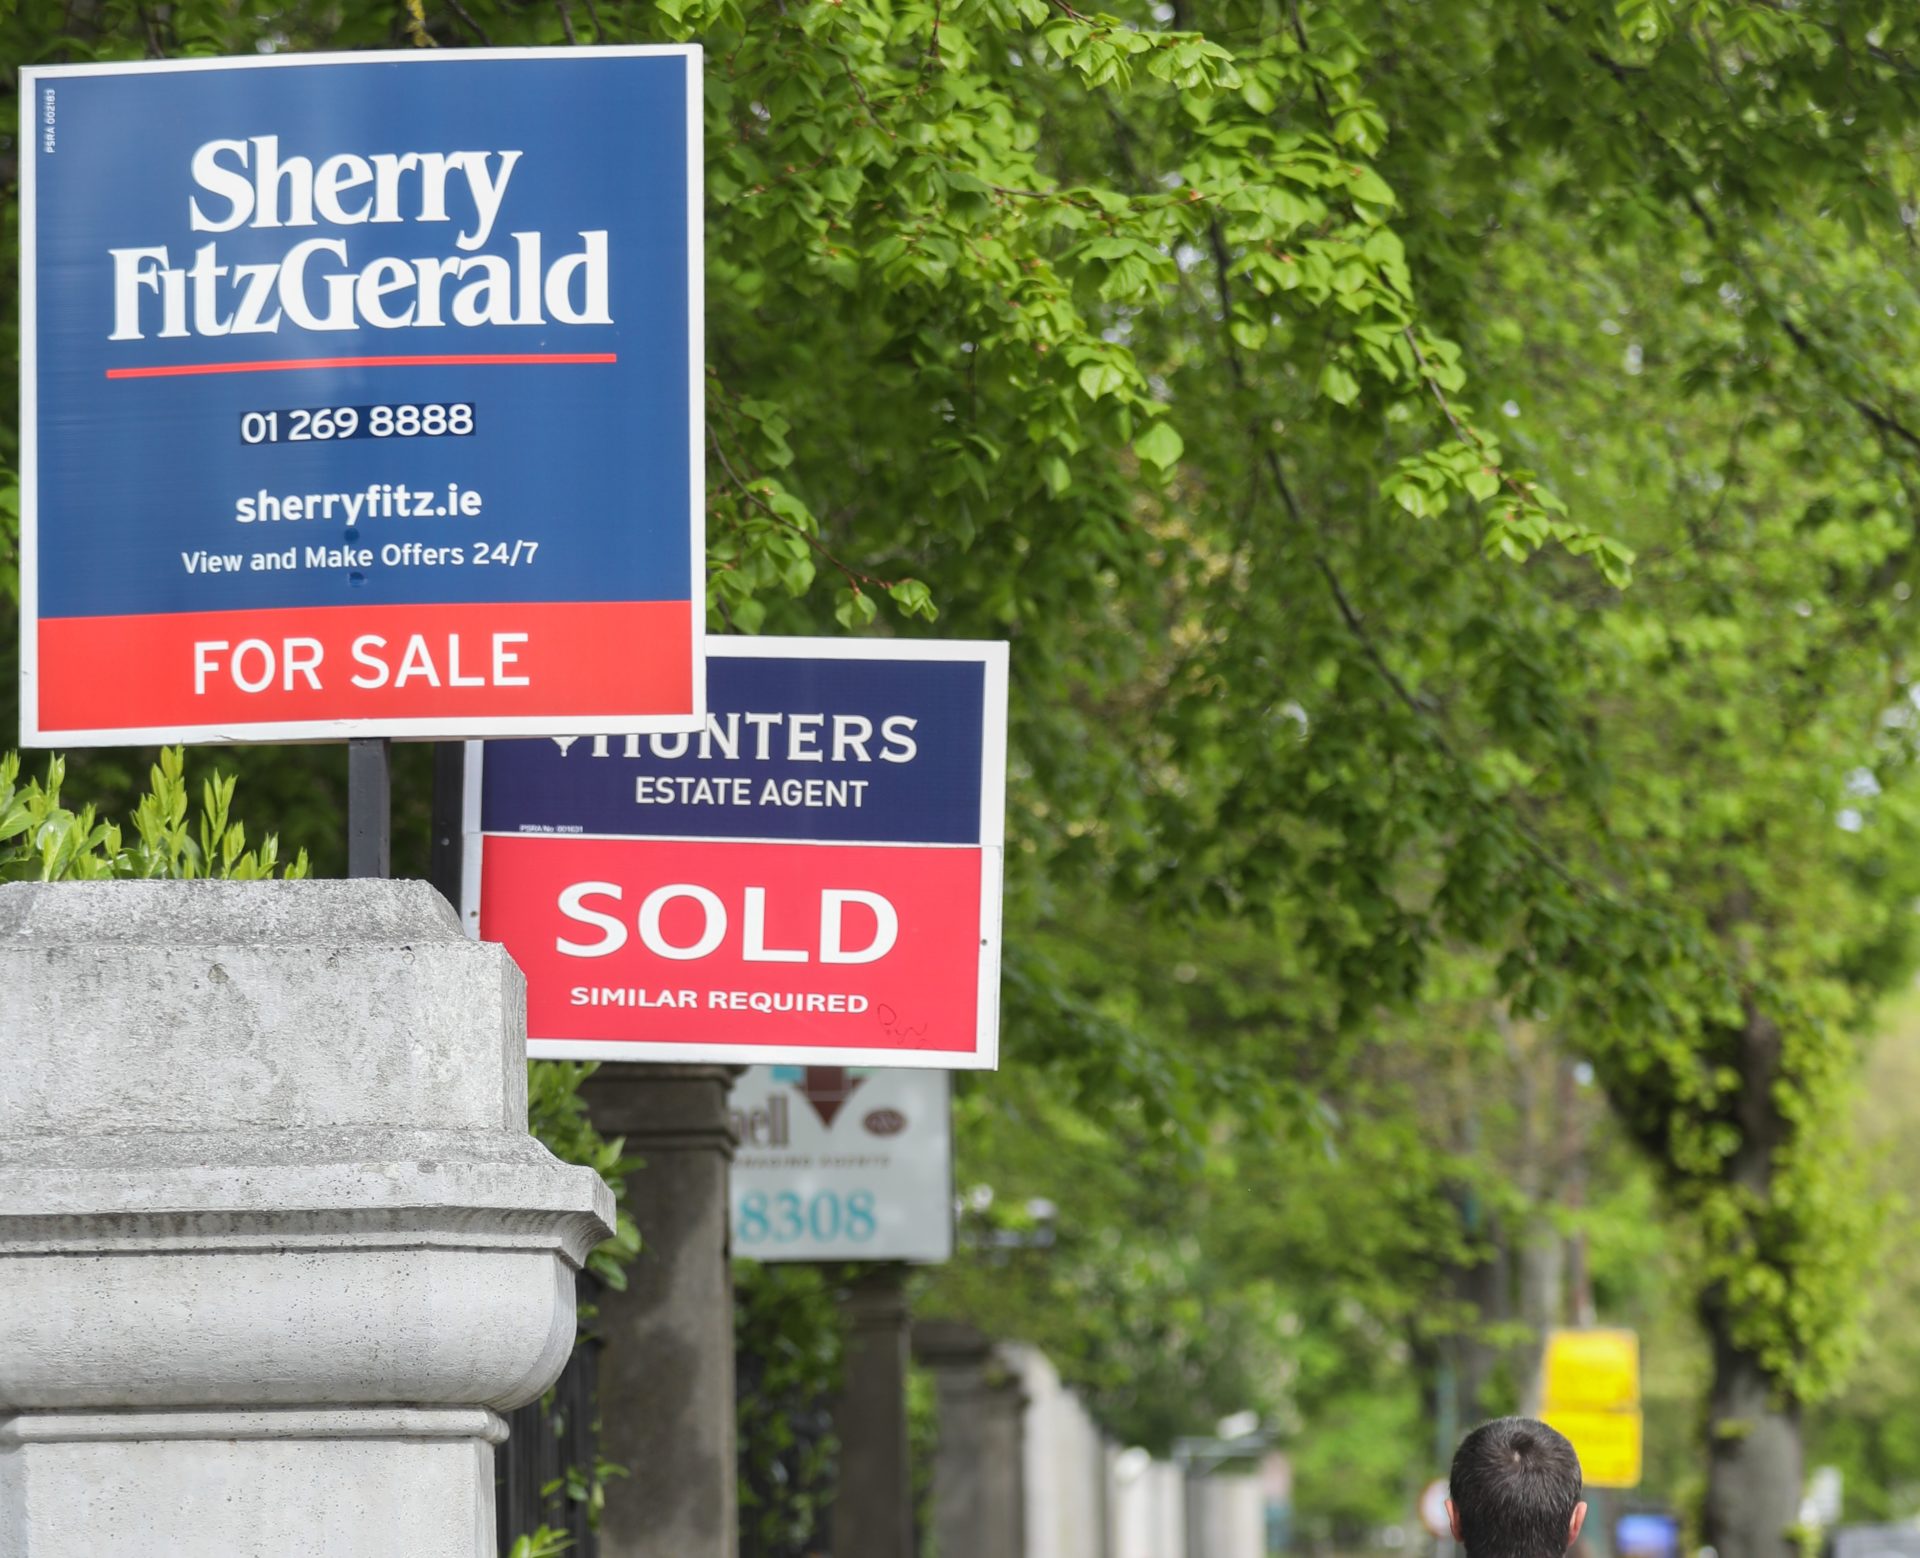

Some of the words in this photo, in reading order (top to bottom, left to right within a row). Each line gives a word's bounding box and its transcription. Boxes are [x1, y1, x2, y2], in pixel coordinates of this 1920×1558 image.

[44, 126, 56, 153] PSRA
[190, 135, 523, 250] Sherry
[108, 230, 613, 340] FitzGerald
[242, 412, 277, 443] 01
[289, 408, 358, 440] 269
[370, 404, 473, 436] 8888
[237, 483, 481, 525] sherryfitz.ie
[182, 551, 242, 573] View
[251, 548, 296, 570] and
[306, 546, 373, 568] Make
[382, 543, 464, 565] Offers
[473, 540, 538, 566] 24/7
[195, 637, 323, 694] FOR
[351, 633, 530, 688] SALE
[637, 777, 751, 805] ESTATE
[760, 779, 868, 807] AGENT
[557, 882, 898, 963] SOLD
[571, 987, 697, 1008] SIMILAR
[709, 991, 868, 1013] REQUIRED
[738, 1189, 876, 1241] 8308
